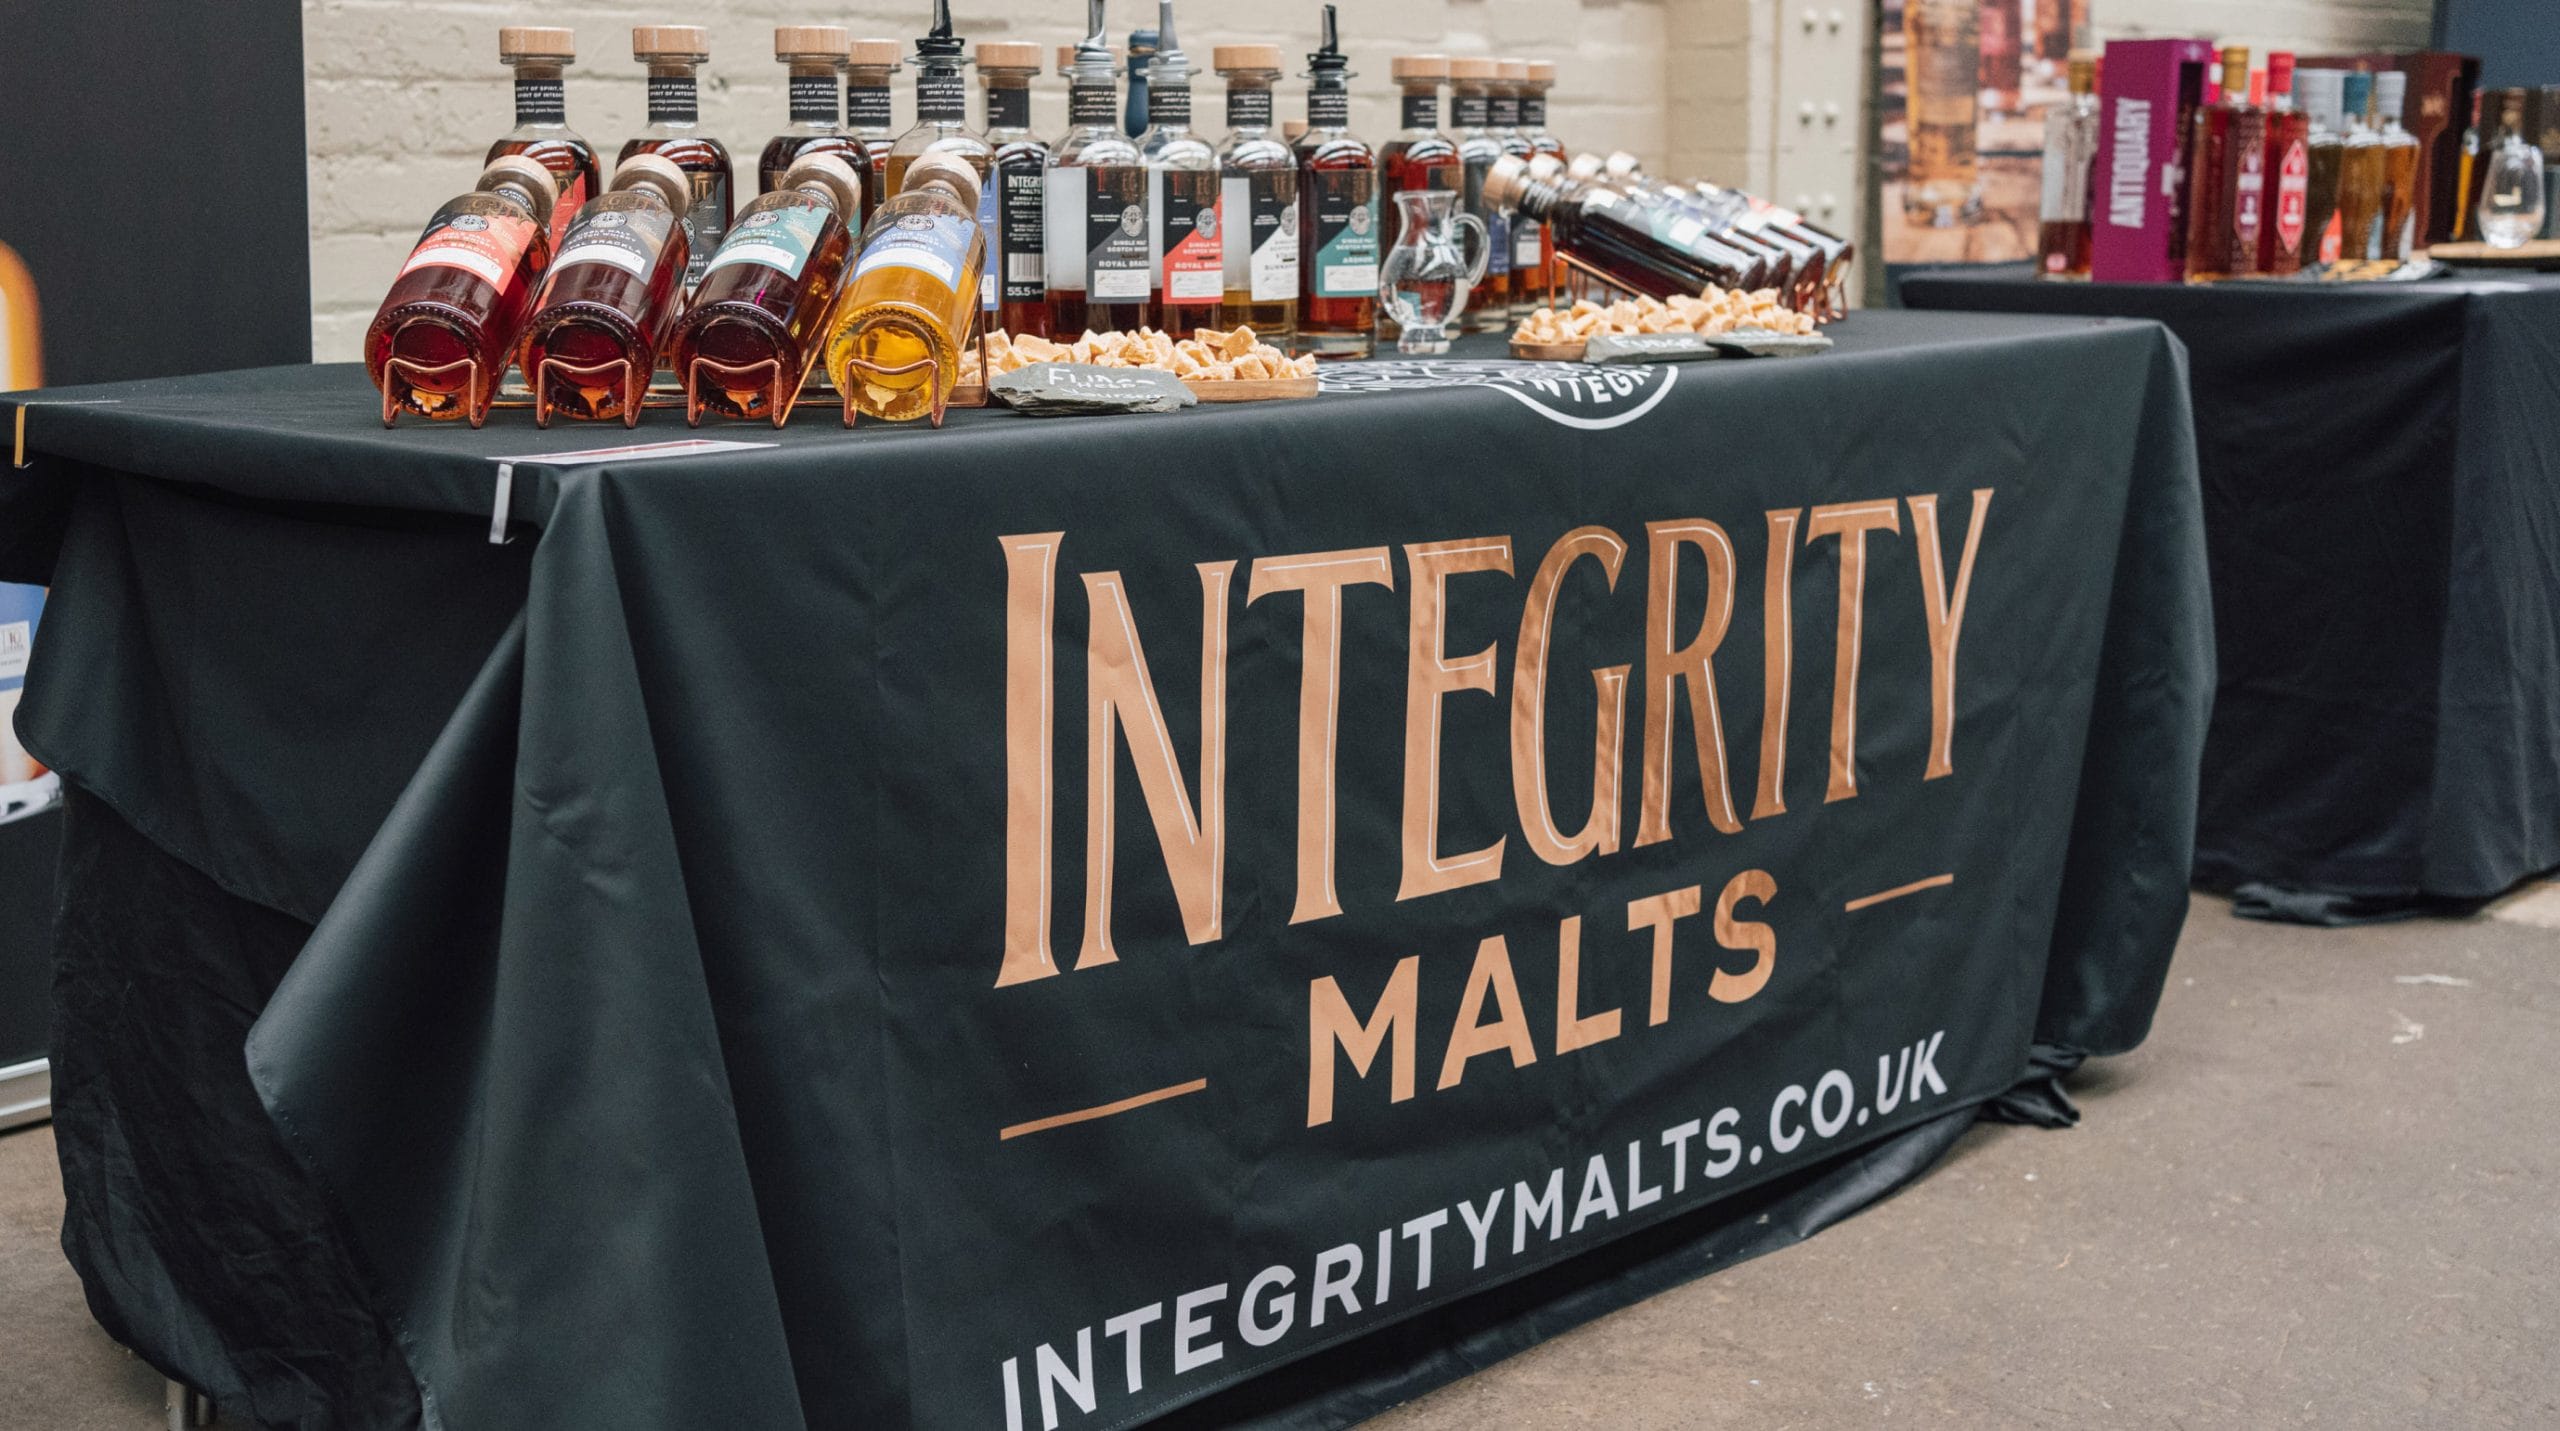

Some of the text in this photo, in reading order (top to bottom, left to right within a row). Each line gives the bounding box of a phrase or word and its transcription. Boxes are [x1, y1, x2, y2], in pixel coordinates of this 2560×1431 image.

[2109, 96, 2151, 229] ANTIQUARY
[994, 487, 1994, 990] INTEGRITY
[1306, 870, 1778, 1129] MALTS
[1001, 1031, 1947, 1431] INTEGRITYMALTS.CO.UK
